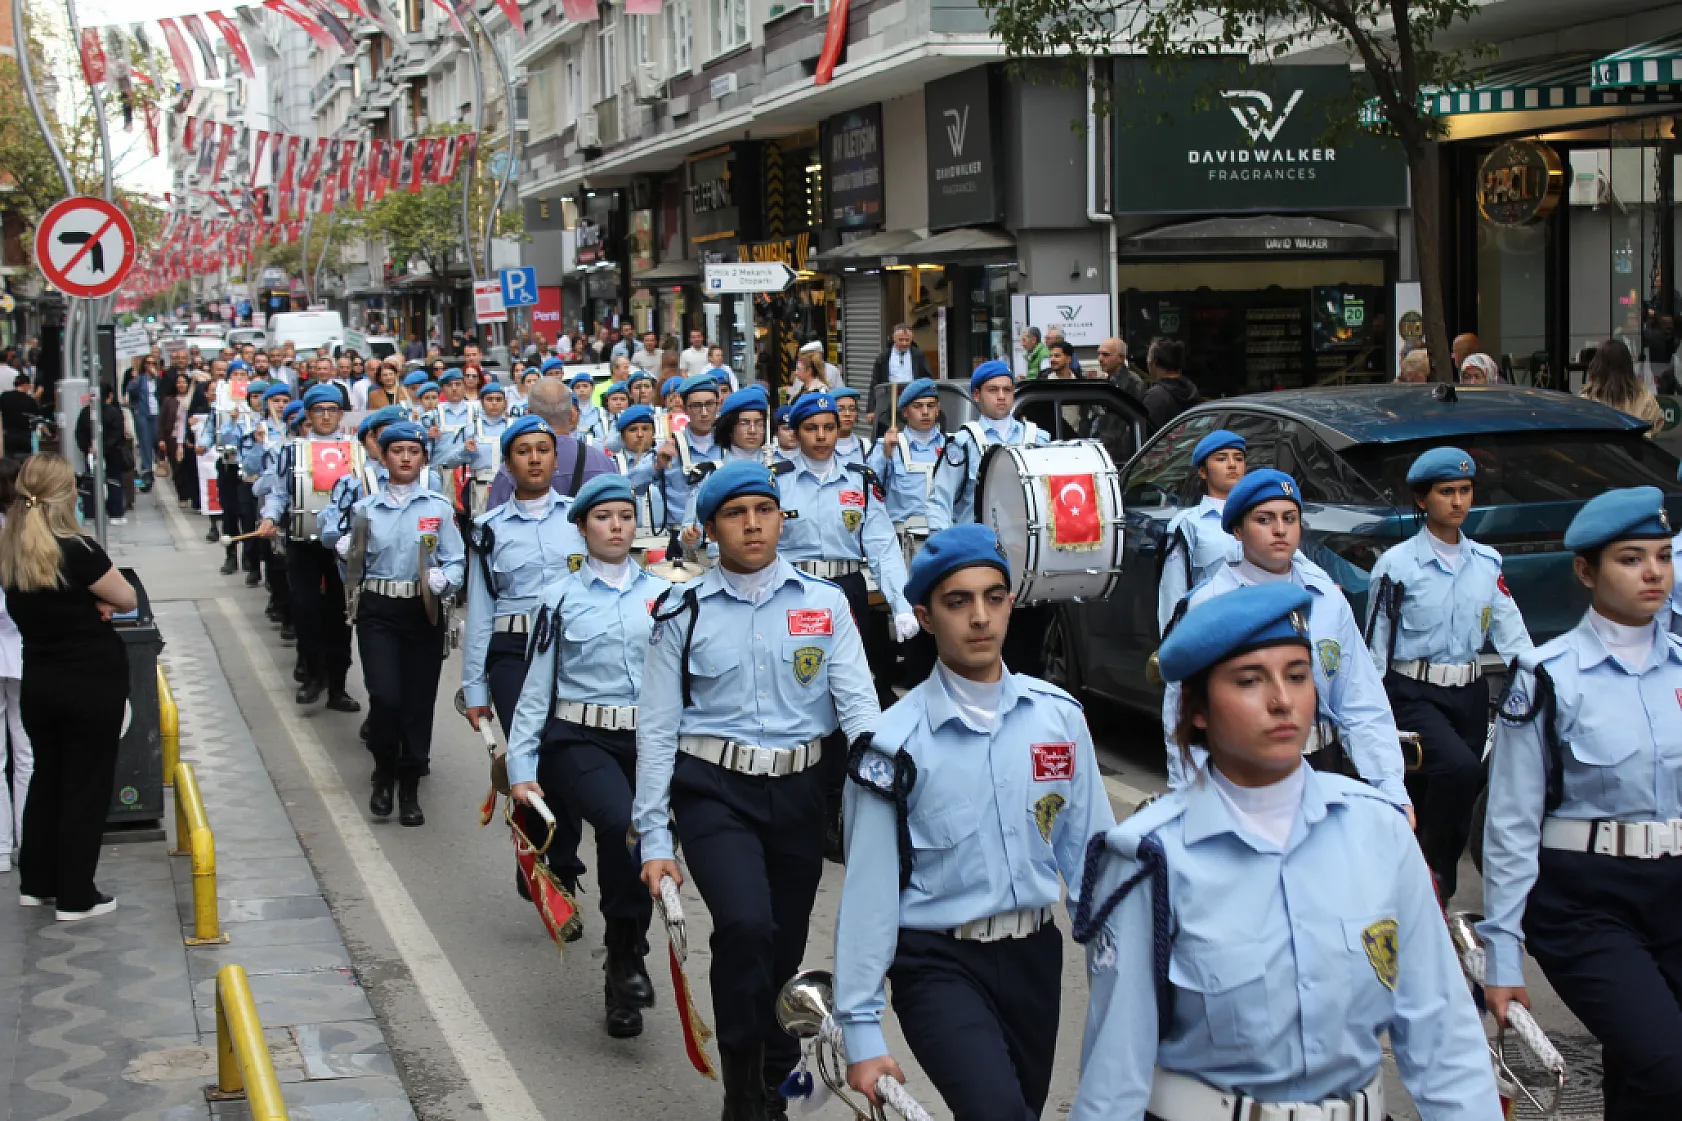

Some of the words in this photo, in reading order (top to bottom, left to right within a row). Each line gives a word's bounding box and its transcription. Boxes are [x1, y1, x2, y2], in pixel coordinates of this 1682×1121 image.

[1208, 168, 1316, 181] FRAGRANCES
[1265, 238, 1292, 249] DAVID
[1294, 237, 1329, 249] WALKER
